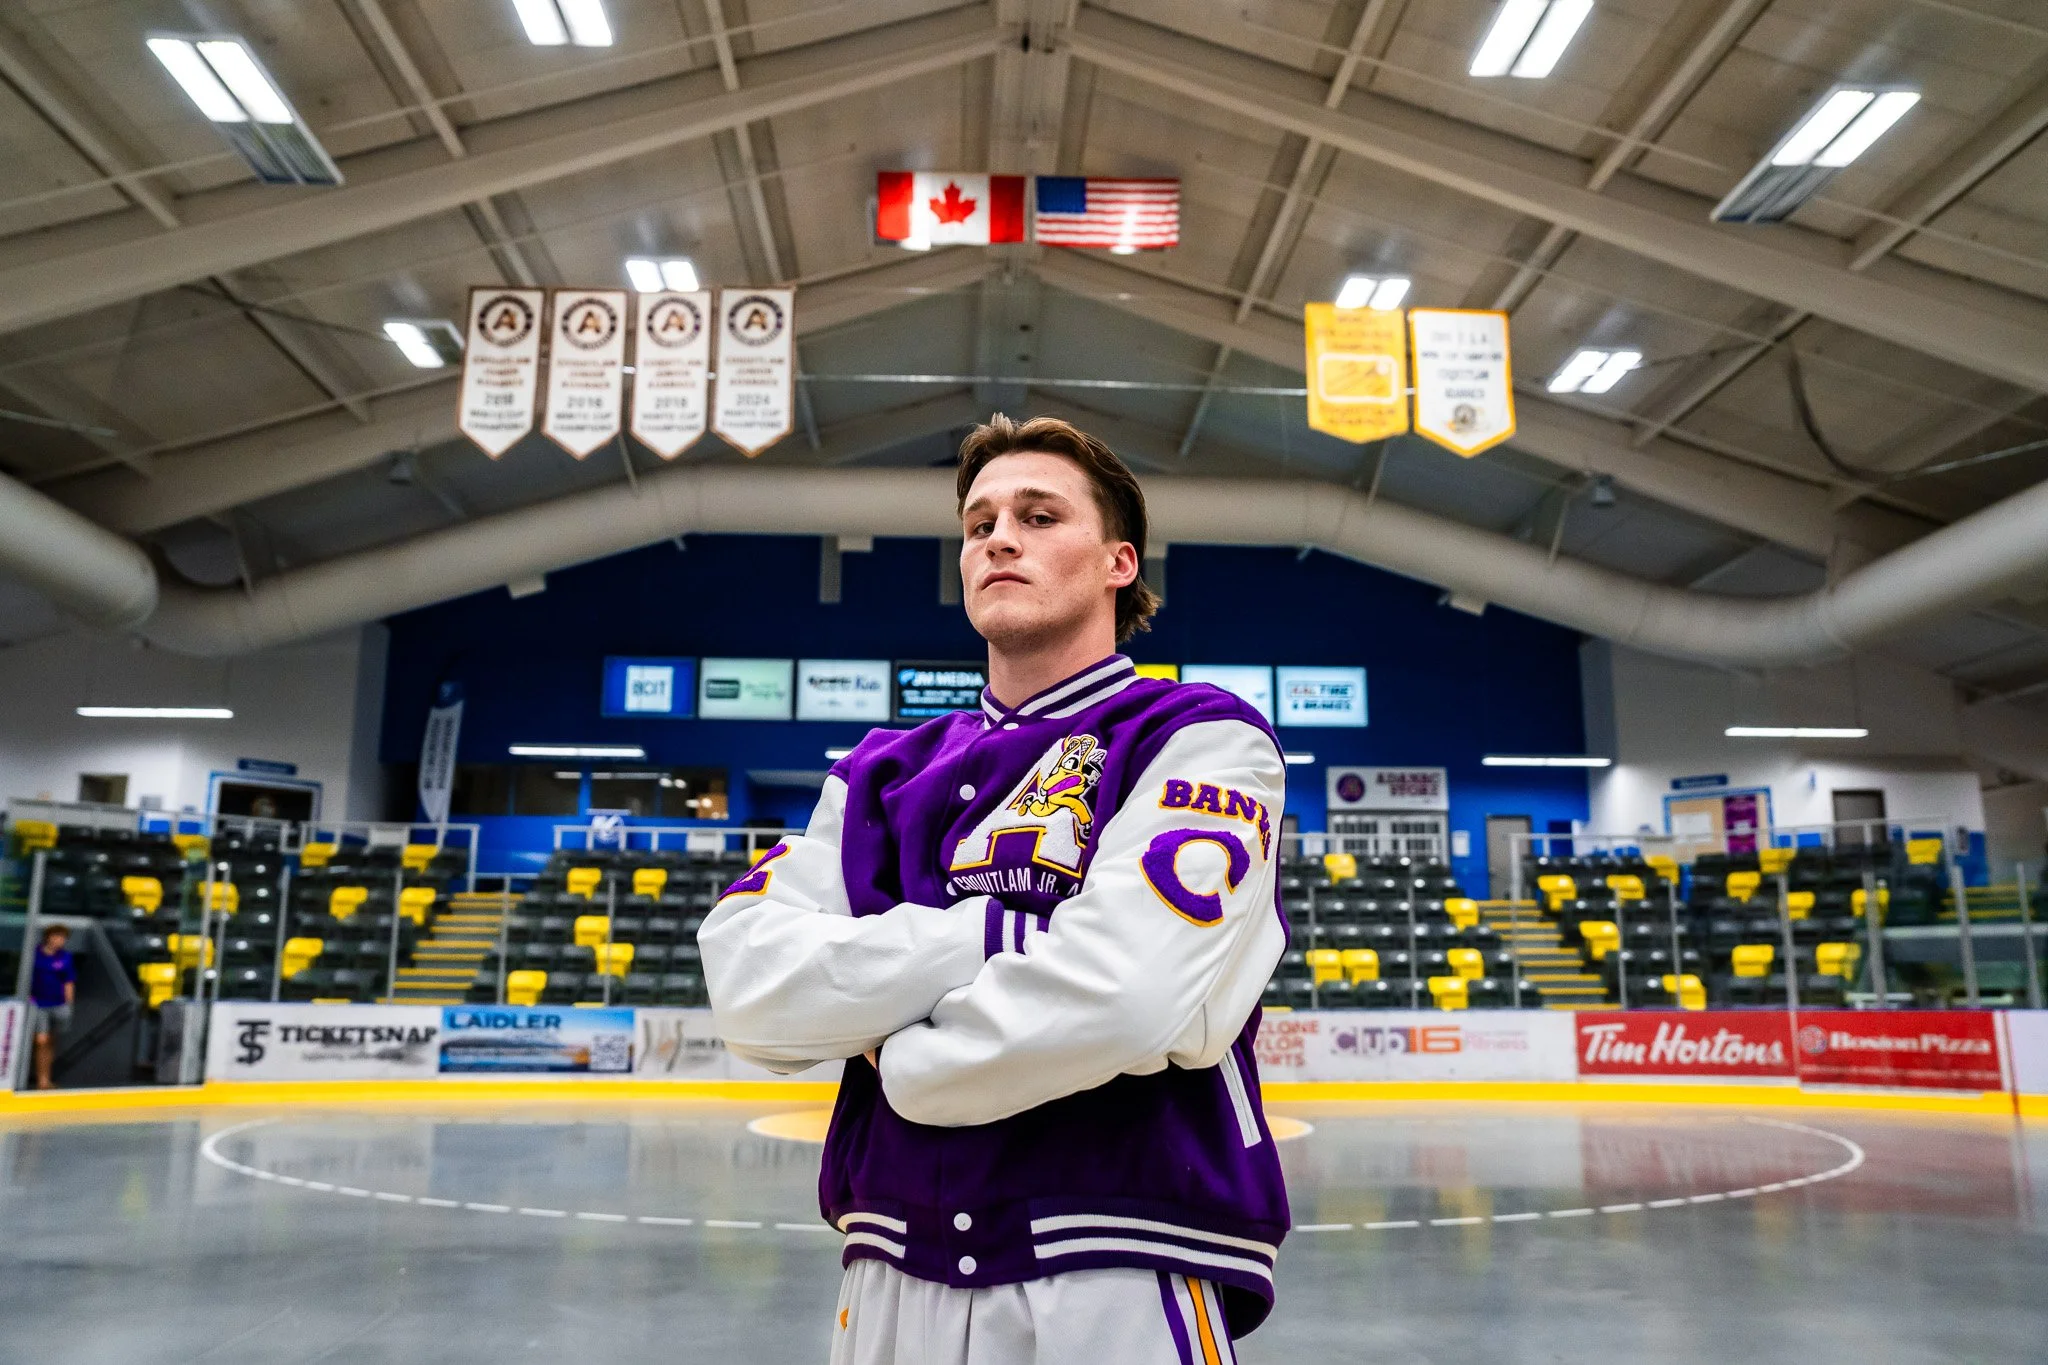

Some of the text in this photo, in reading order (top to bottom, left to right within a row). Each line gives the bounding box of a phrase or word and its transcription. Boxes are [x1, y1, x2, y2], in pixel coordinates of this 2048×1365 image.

[952, 867, 1032, 894] COQUITLAM
[1037, 871, 1059, 895] JR.
[1138, 828, 1251, 928] C
[278, 1025, 438, 1044] TICKETSNAP
[449, 1012, 562, 1030] LAIDLER
[1582, 1021, 1785, 1066] Tim Hortons
